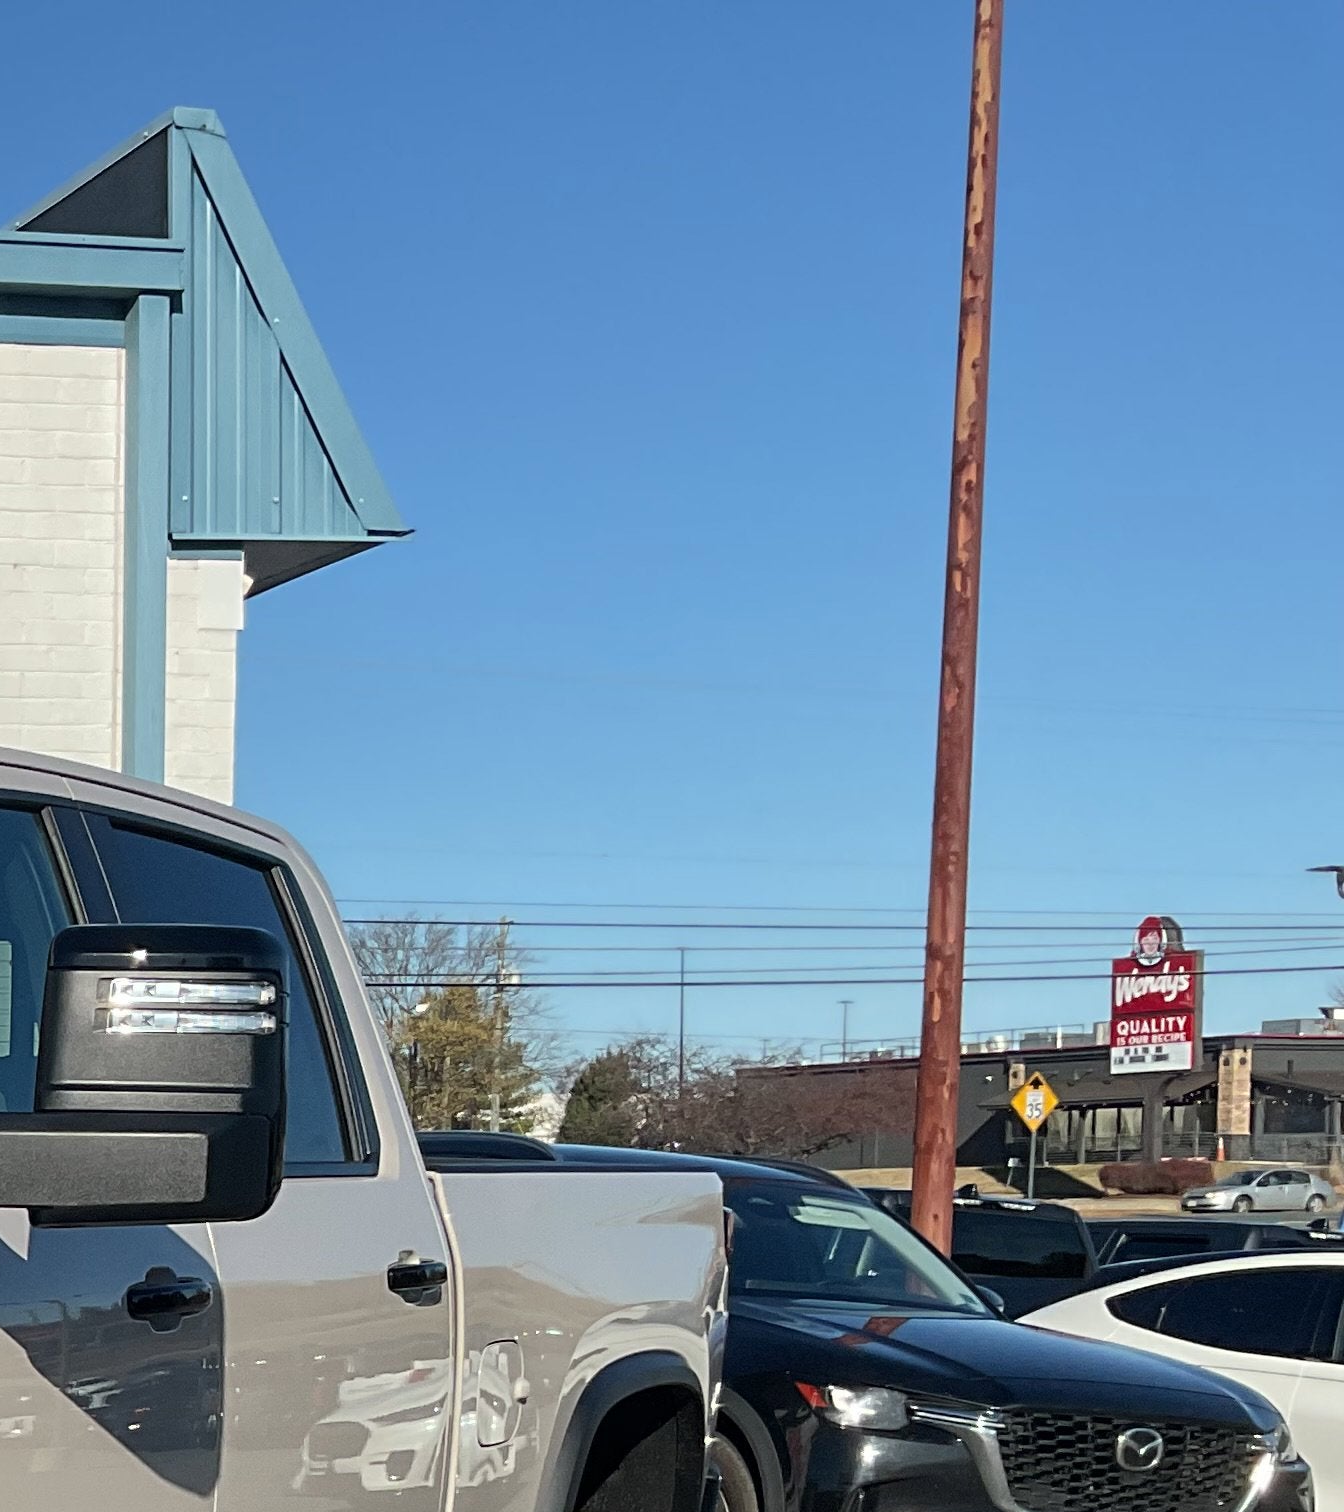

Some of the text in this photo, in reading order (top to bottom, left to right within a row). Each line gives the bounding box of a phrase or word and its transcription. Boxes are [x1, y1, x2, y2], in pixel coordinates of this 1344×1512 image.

[1115, 961, 1191, 1007] Wendy's
[1116, 1016, 1187, 1036] QUALITY
[1116, 1032, 1187, 1046] IS OUR RECIPE
[1027, 1102, 1042, 1119] 35
